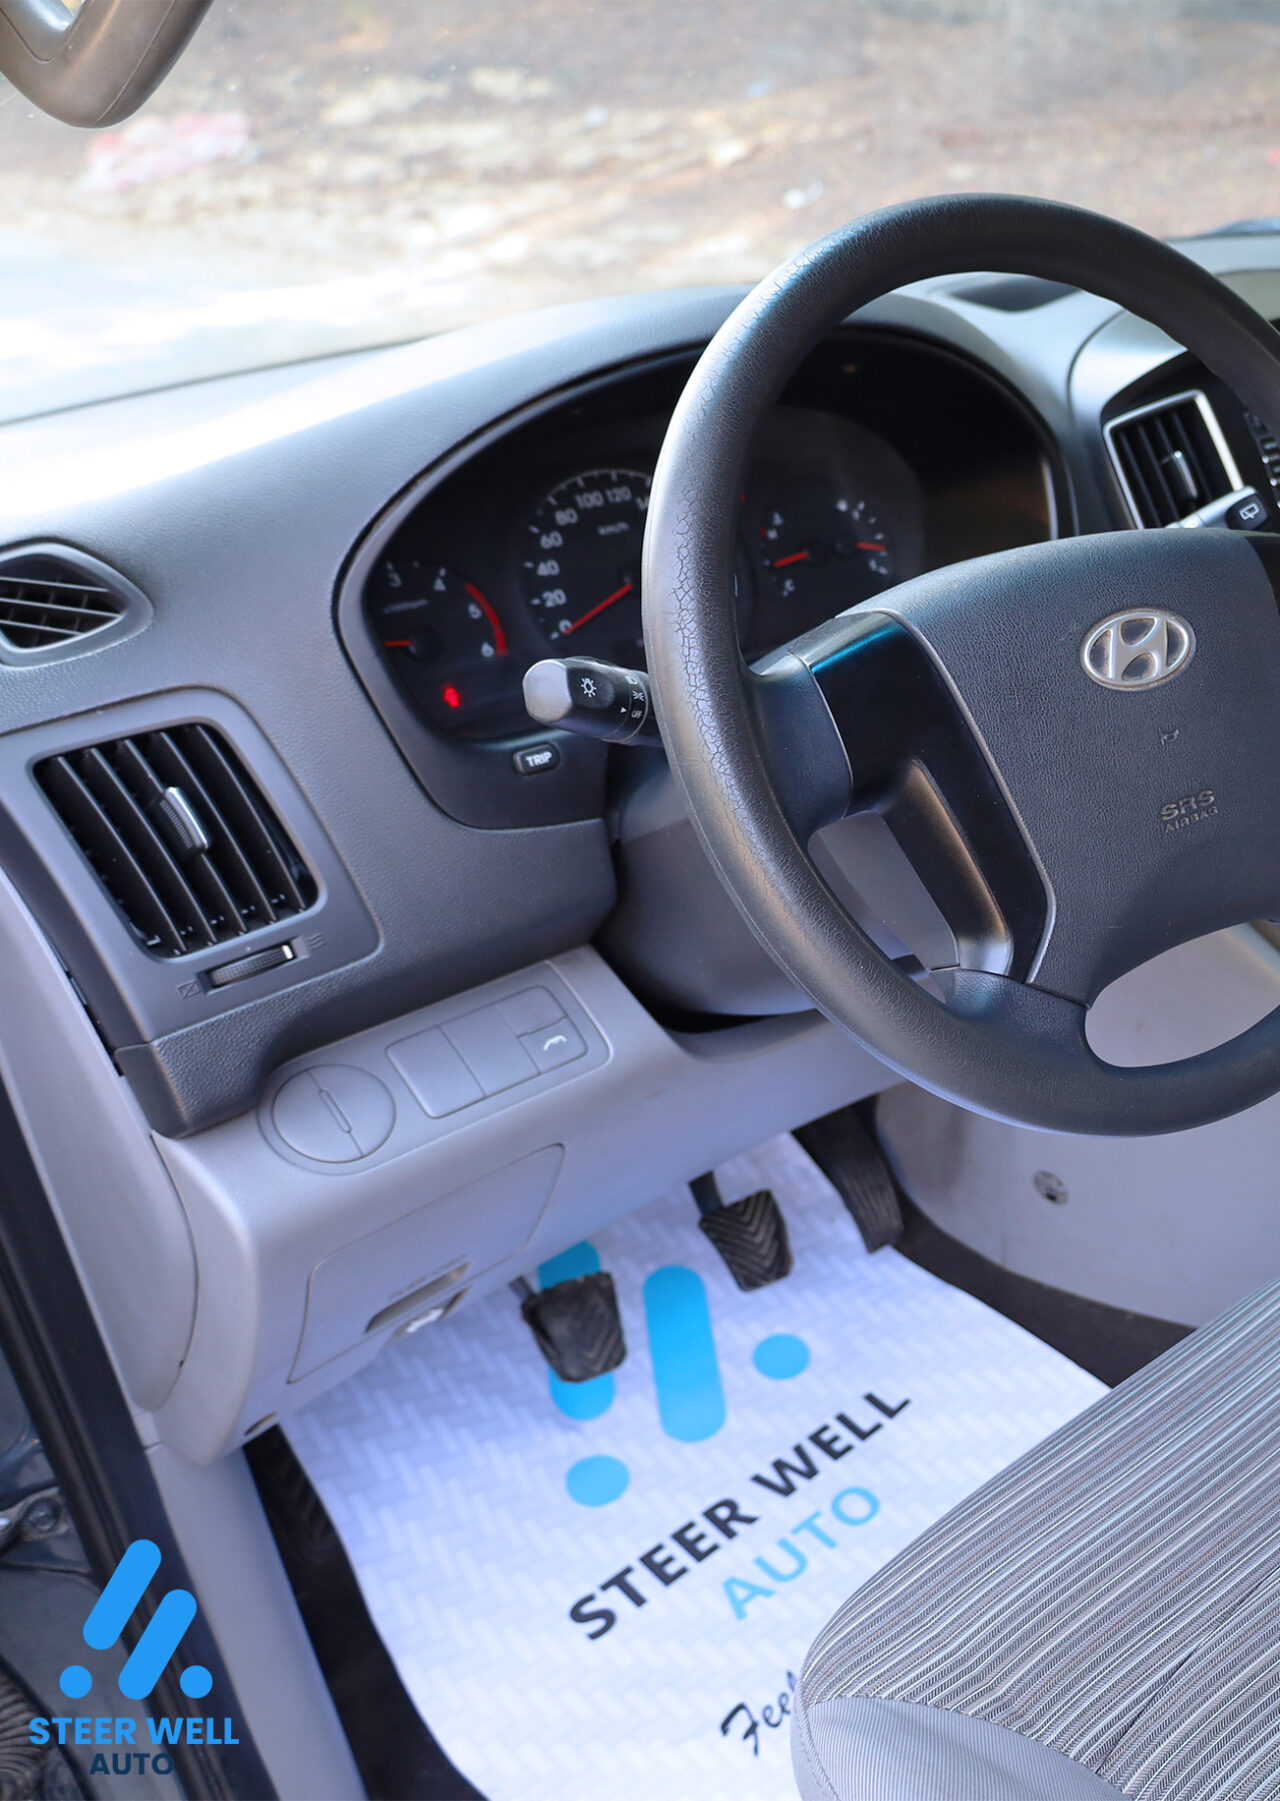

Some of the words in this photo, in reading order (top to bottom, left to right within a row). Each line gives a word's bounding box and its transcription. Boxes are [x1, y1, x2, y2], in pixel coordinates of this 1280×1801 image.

[575, 491, 604, 509] 100
[606, 486, 632, 503] 120
[555, 508, 578, 526] 80
[540, 531, 563, 549] 60
[537, 559, 561, 576] 40
[542, 589, 567, 607] 20
[481, 641, 495, 657] 6
[631, 710, 643, 719] OFF
[526, 751, 552, 767] TRIP
[1165, 806, 1218, 832] AIRBAG
[568, 1498, 760, 1640] STEER
[750, 1392, 911, 1497] WELL
[721, 1486, 881, 1621] AUTO
